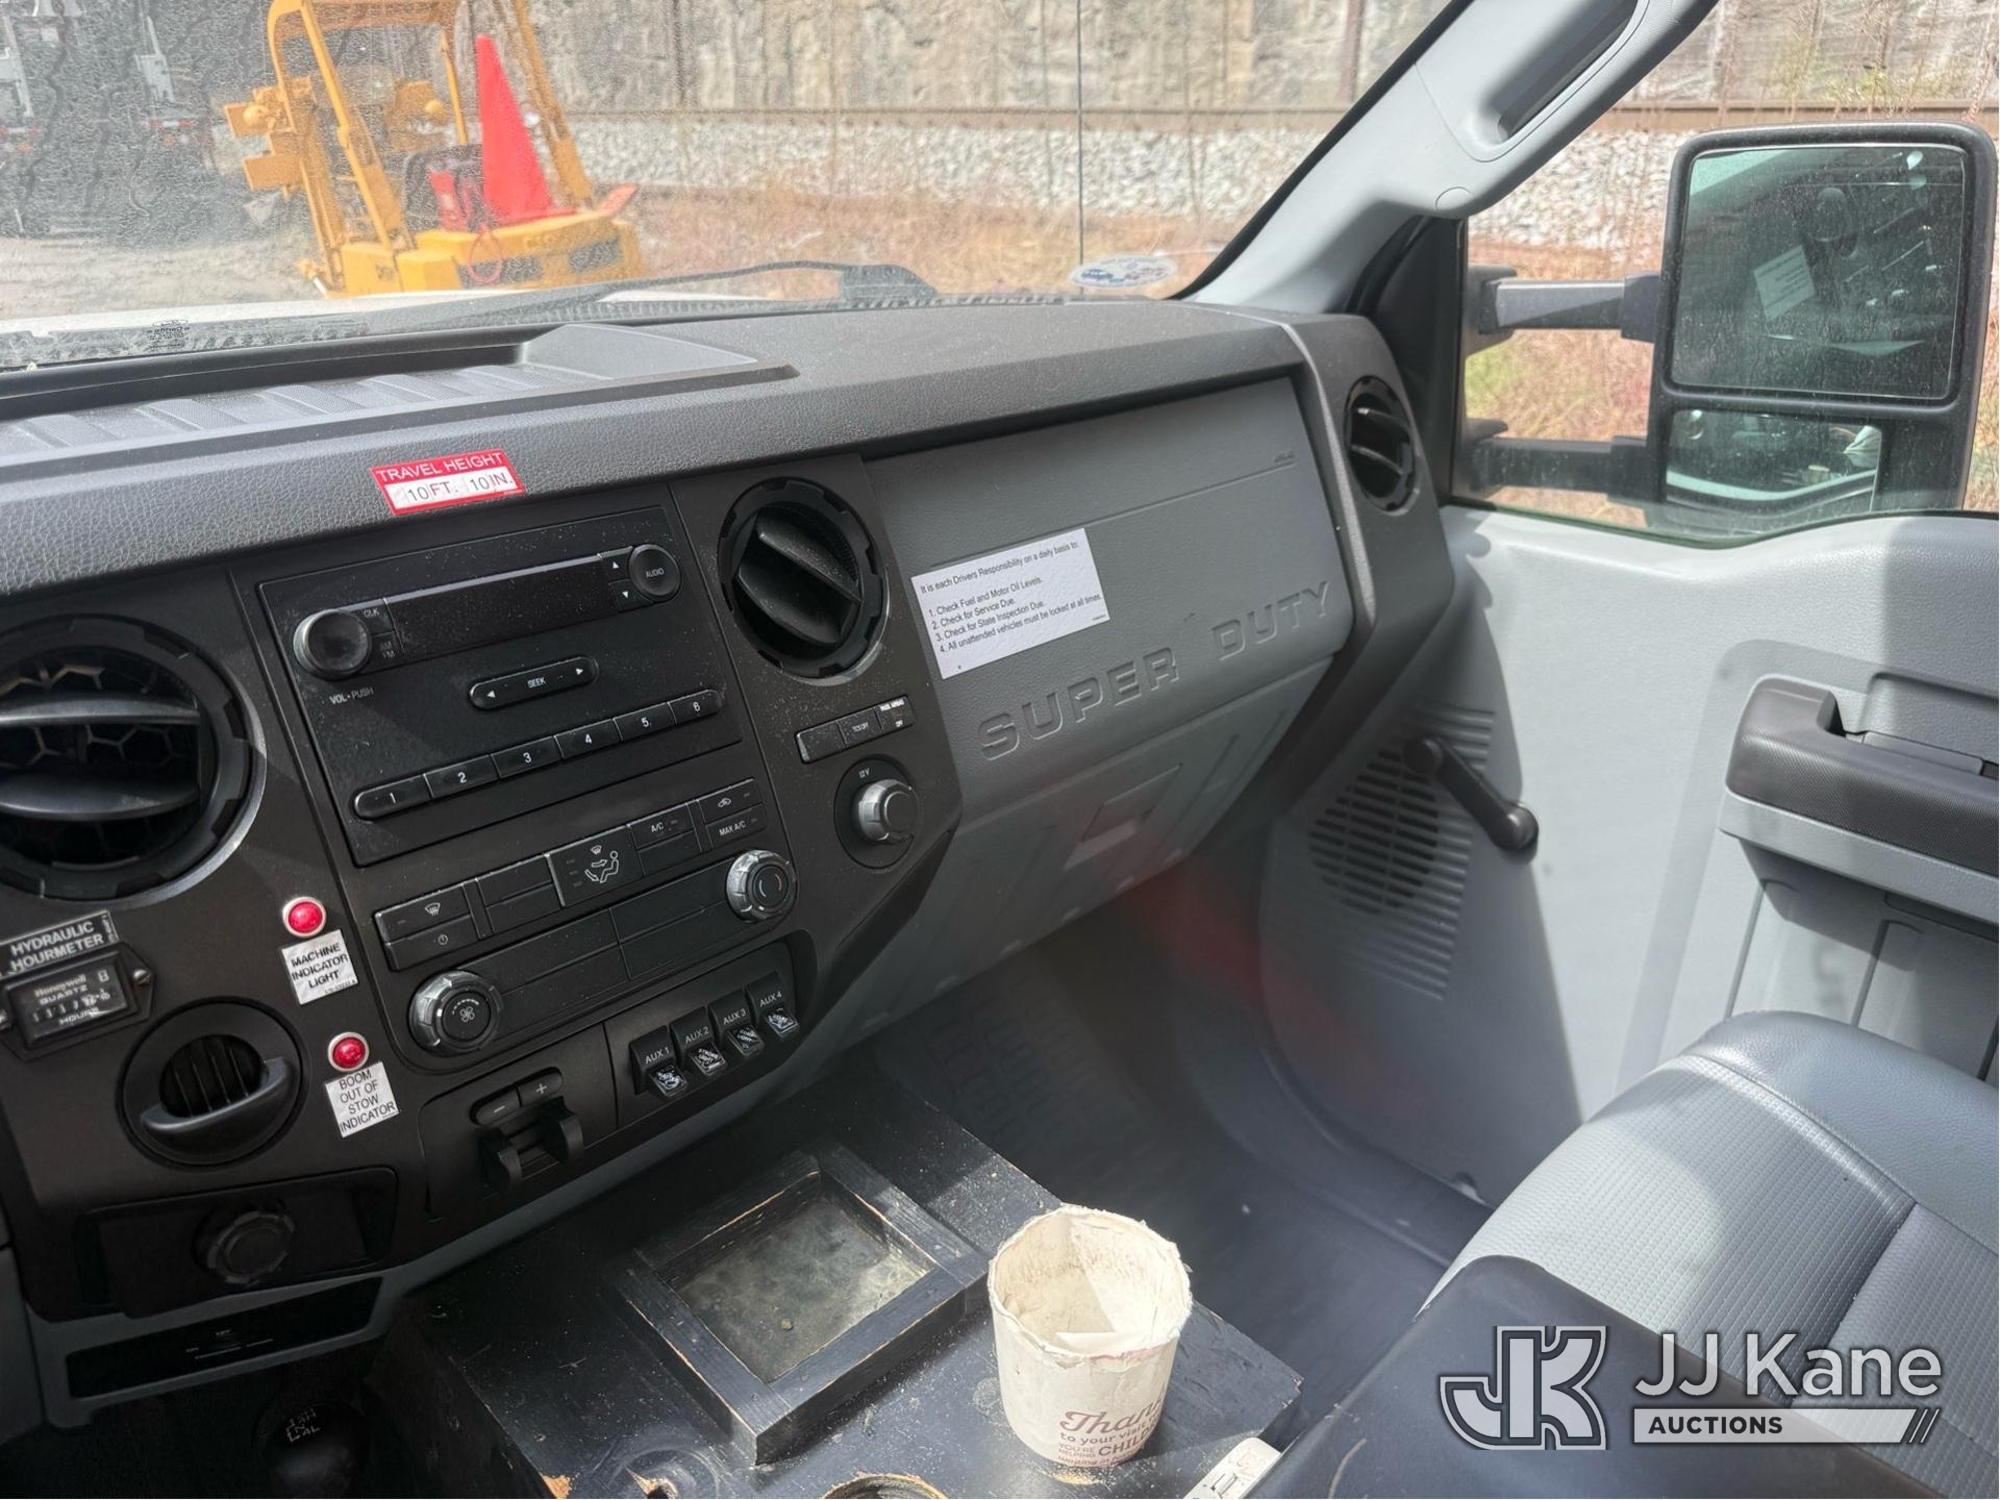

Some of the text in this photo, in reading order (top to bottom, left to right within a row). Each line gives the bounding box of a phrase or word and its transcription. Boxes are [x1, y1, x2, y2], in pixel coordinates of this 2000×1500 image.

[375, 452, 502, 482] TRAVEL HEIGHT
[935, 578, 953, 591] each
[953, 570, 978, 585] Drivers
[978, 557, 1023, 577] Responsibility
[1023, 555, 1033, 564] on
[1039, 549, 1054, 560] daily
[1054, 544, 1070, 555] basis
[936, 602, 960, 616] Check
[960, 596, 976, 608] Fuel
[977, 590, 990, 602] and
[990, 585, 1010, 598] Motor
[1010, 581, 1020, 593] Oil
[940, 615, 964, 628] Check
[963, 608, 974, 620] for
[974, 603, 1000, 617] Service
[944, 627, 966, 640] Check
[967, 620, 977, 631] for
[977, 615, 996, 628] State
[996, 604, 1030, 623] Inspection
[948, 640, 957, 650] All
[958, 628, 996, 646] unattended
[996, 619, 1023, 633] vehicles
[1023, 613, 1039, 625] must
[1039, 610, 1049, 619] be
[1049, 603, 1070, 616] locked
[977, 580, 1330, 761] SUPER DUTY
[641, 717, 649, 728] 5
[584, 734, 593, 745] 4
[523, 752, 533, 764] 3
[457, 771, 468, 784] 2
[651, 822, 664, 833] A/C
[719, 820, 747, 836] MAX A/C
[10, 921, 95, 956] HYDRAULIC
[10, 933, 105, 972] HOURMETER
[291, 943, 341, 967] MACHINE
[292, 954, 349, 980] INDICATOR
[308, 970, 341, 989] LIGHT
[760, 990, 783, 1008] AUX 4
[723, 1008, 747, 1025] AUX 3
[685, 1026, 710, 1045] AUX 2
[645, 1047, 670, 1065] AUX 1
[339, 1069, 372, 1090] BOOM
[339, 1079, 378, 1105] OUT OF
[348, 1094, 379, 1115] STOW
[339, 1102, 396, 1133] INDICATOR
[1060, 1432, 1075, 1442] to
[1080, 1435, 1115, 1446] your
